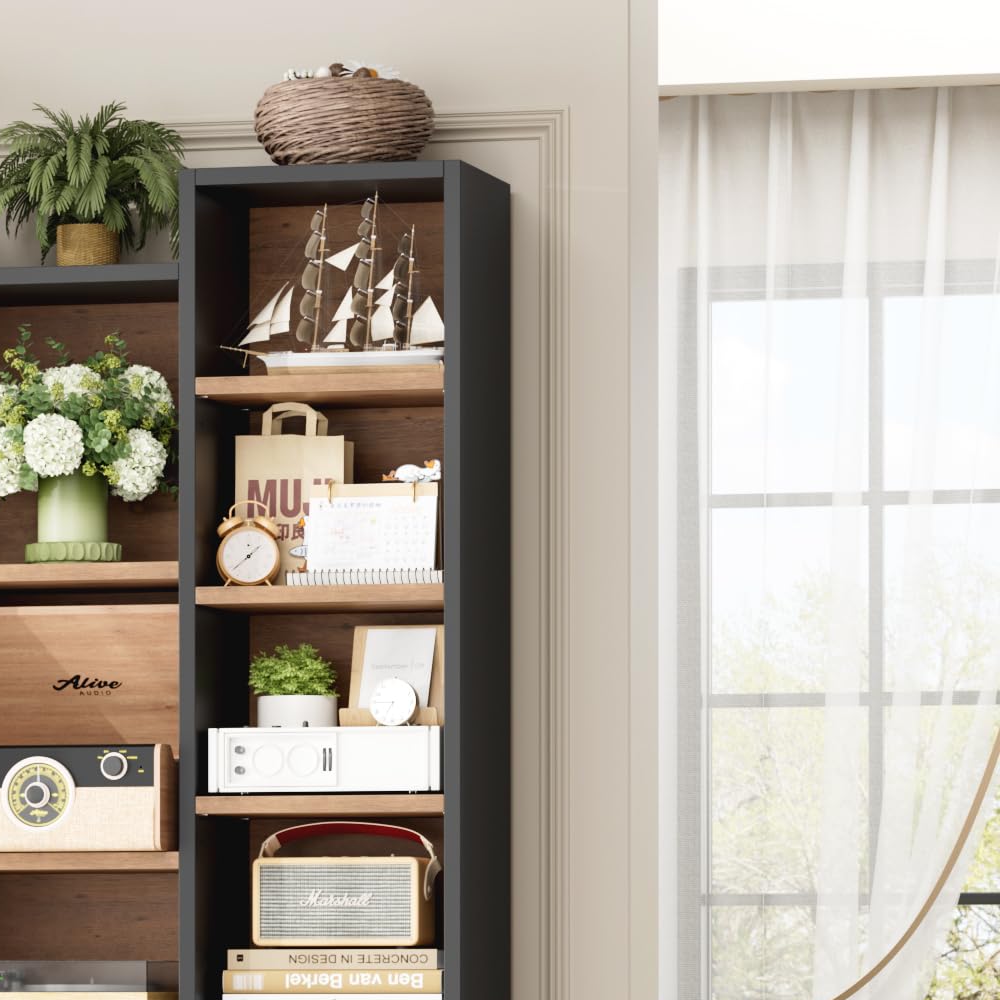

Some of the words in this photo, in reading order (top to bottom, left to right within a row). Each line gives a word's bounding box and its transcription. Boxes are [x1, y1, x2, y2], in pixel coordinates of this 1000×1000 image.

[52, 674, 122, 692] Alive
[299, 888, 374, 907] Marshall
[288, 953, 336, 964] DESIGN
[340, 953, 353, 964] IN
[357, 953, 428, 964] CONCRETE
[286, 973, 342, 989] Berkel
[349, 973, 382, 986] van
[388, 973, 424, 989] Ben
